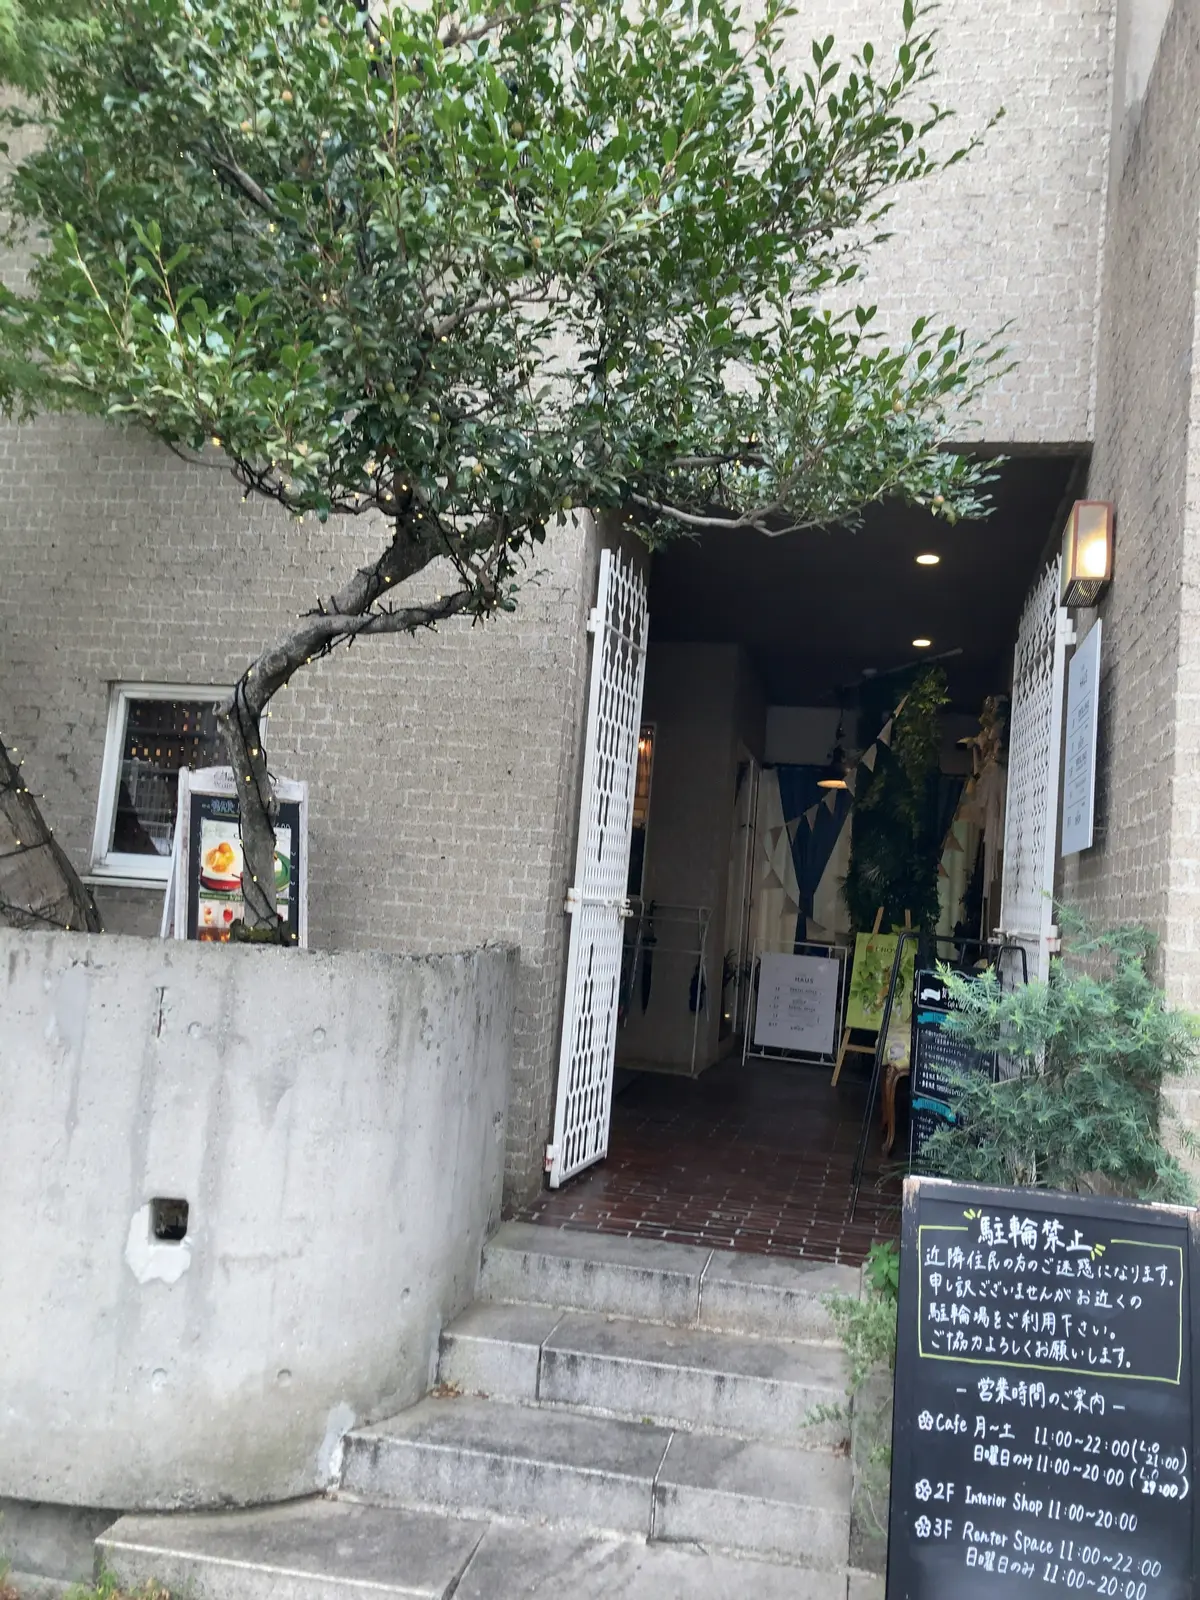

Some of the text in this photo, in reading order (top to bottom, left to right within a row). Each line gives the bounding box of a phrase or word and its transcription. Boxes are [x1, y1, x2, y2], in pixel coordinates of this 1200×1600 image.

[978, 1215, 1094, 1254] 駐輪禁止
[924, 1247, 1175, 1287] 近隣住民の方のご迷惑になります。
[928, 1302, 1116, 1340] 駐輪場をご利用下さい。
[931, 1328, 1131, 1369] ご協力よろしくお願いします。
[936, 1413, 968, 1435] Cafe
[973, 1445, 1034, 1470] 日曜日のみ
[933, 1482, 955, 1502] 2F
[965, 1485, 1007, 1509] Interior
[1012, 1492, 1043, 1517] Shop
[933, 1519, 953, 1540] 3F
[1013, 1529, 1054, 1555] Space
[966, 1547, 1036, 1579] 日曜日のみ
